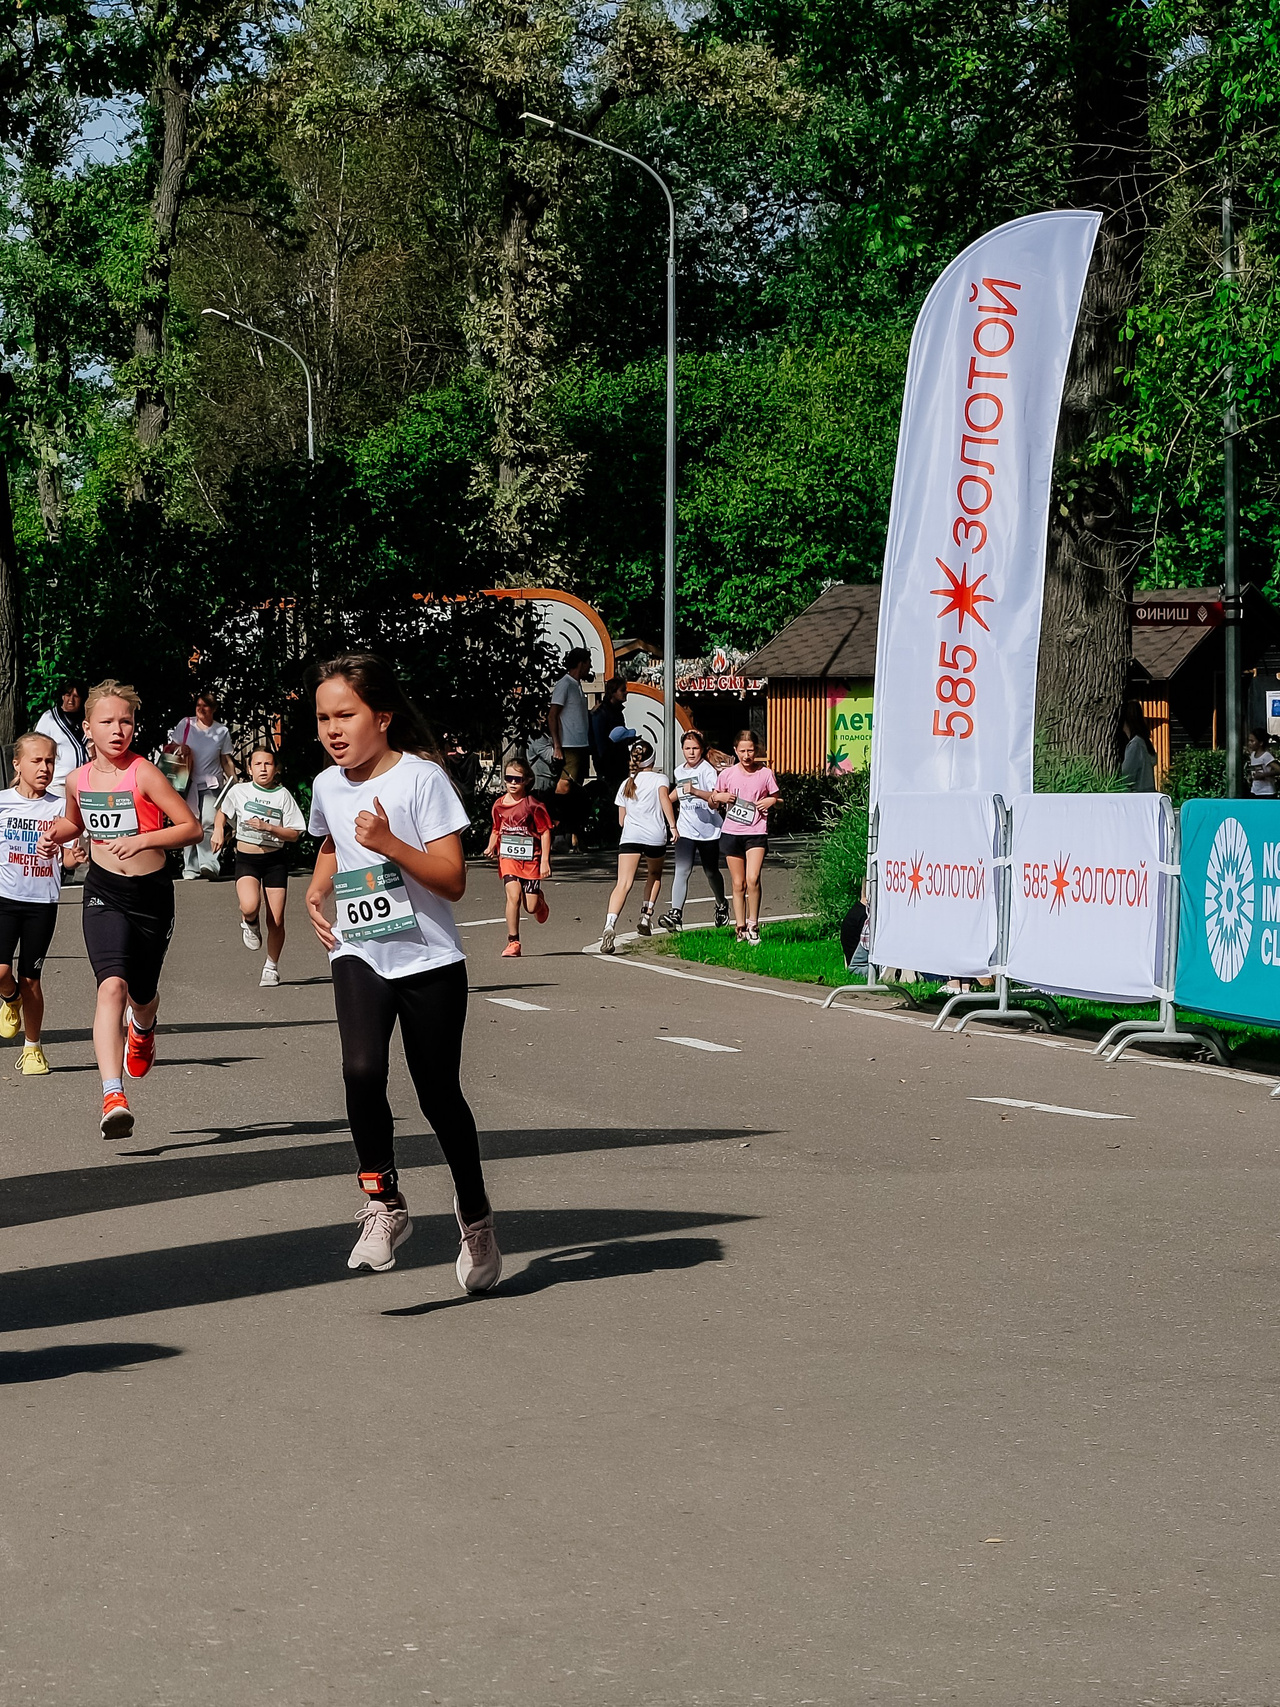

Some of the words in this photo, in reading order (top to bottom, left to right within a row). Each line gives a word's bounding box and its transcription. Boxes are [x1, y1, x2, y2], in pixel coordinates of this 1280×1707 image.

[953, 277, 1022, 554] ЗОЛОТОЙ
[1136, 608, 1189, 620] ФИНИШ
[678, 676, 715, 691] CAFE
[932, 641, 978, 740] 585
[6, 817, 54, 832] #ЗАБЕГ202
[89, 813, 122, 829] 607
[507, 845, 527, 854] 659
[8, 851, 39, 866] ВМЕСТЕ
[885, 860, 907, 893] 585
[925, 858, 985, 900] ЗОЛОТОЙ
[1023, 863, 1048, 899] 585
[1071, 860, 1148, 908] ЗОЛОТОЙ
[347, 896, 391, 924] 609
